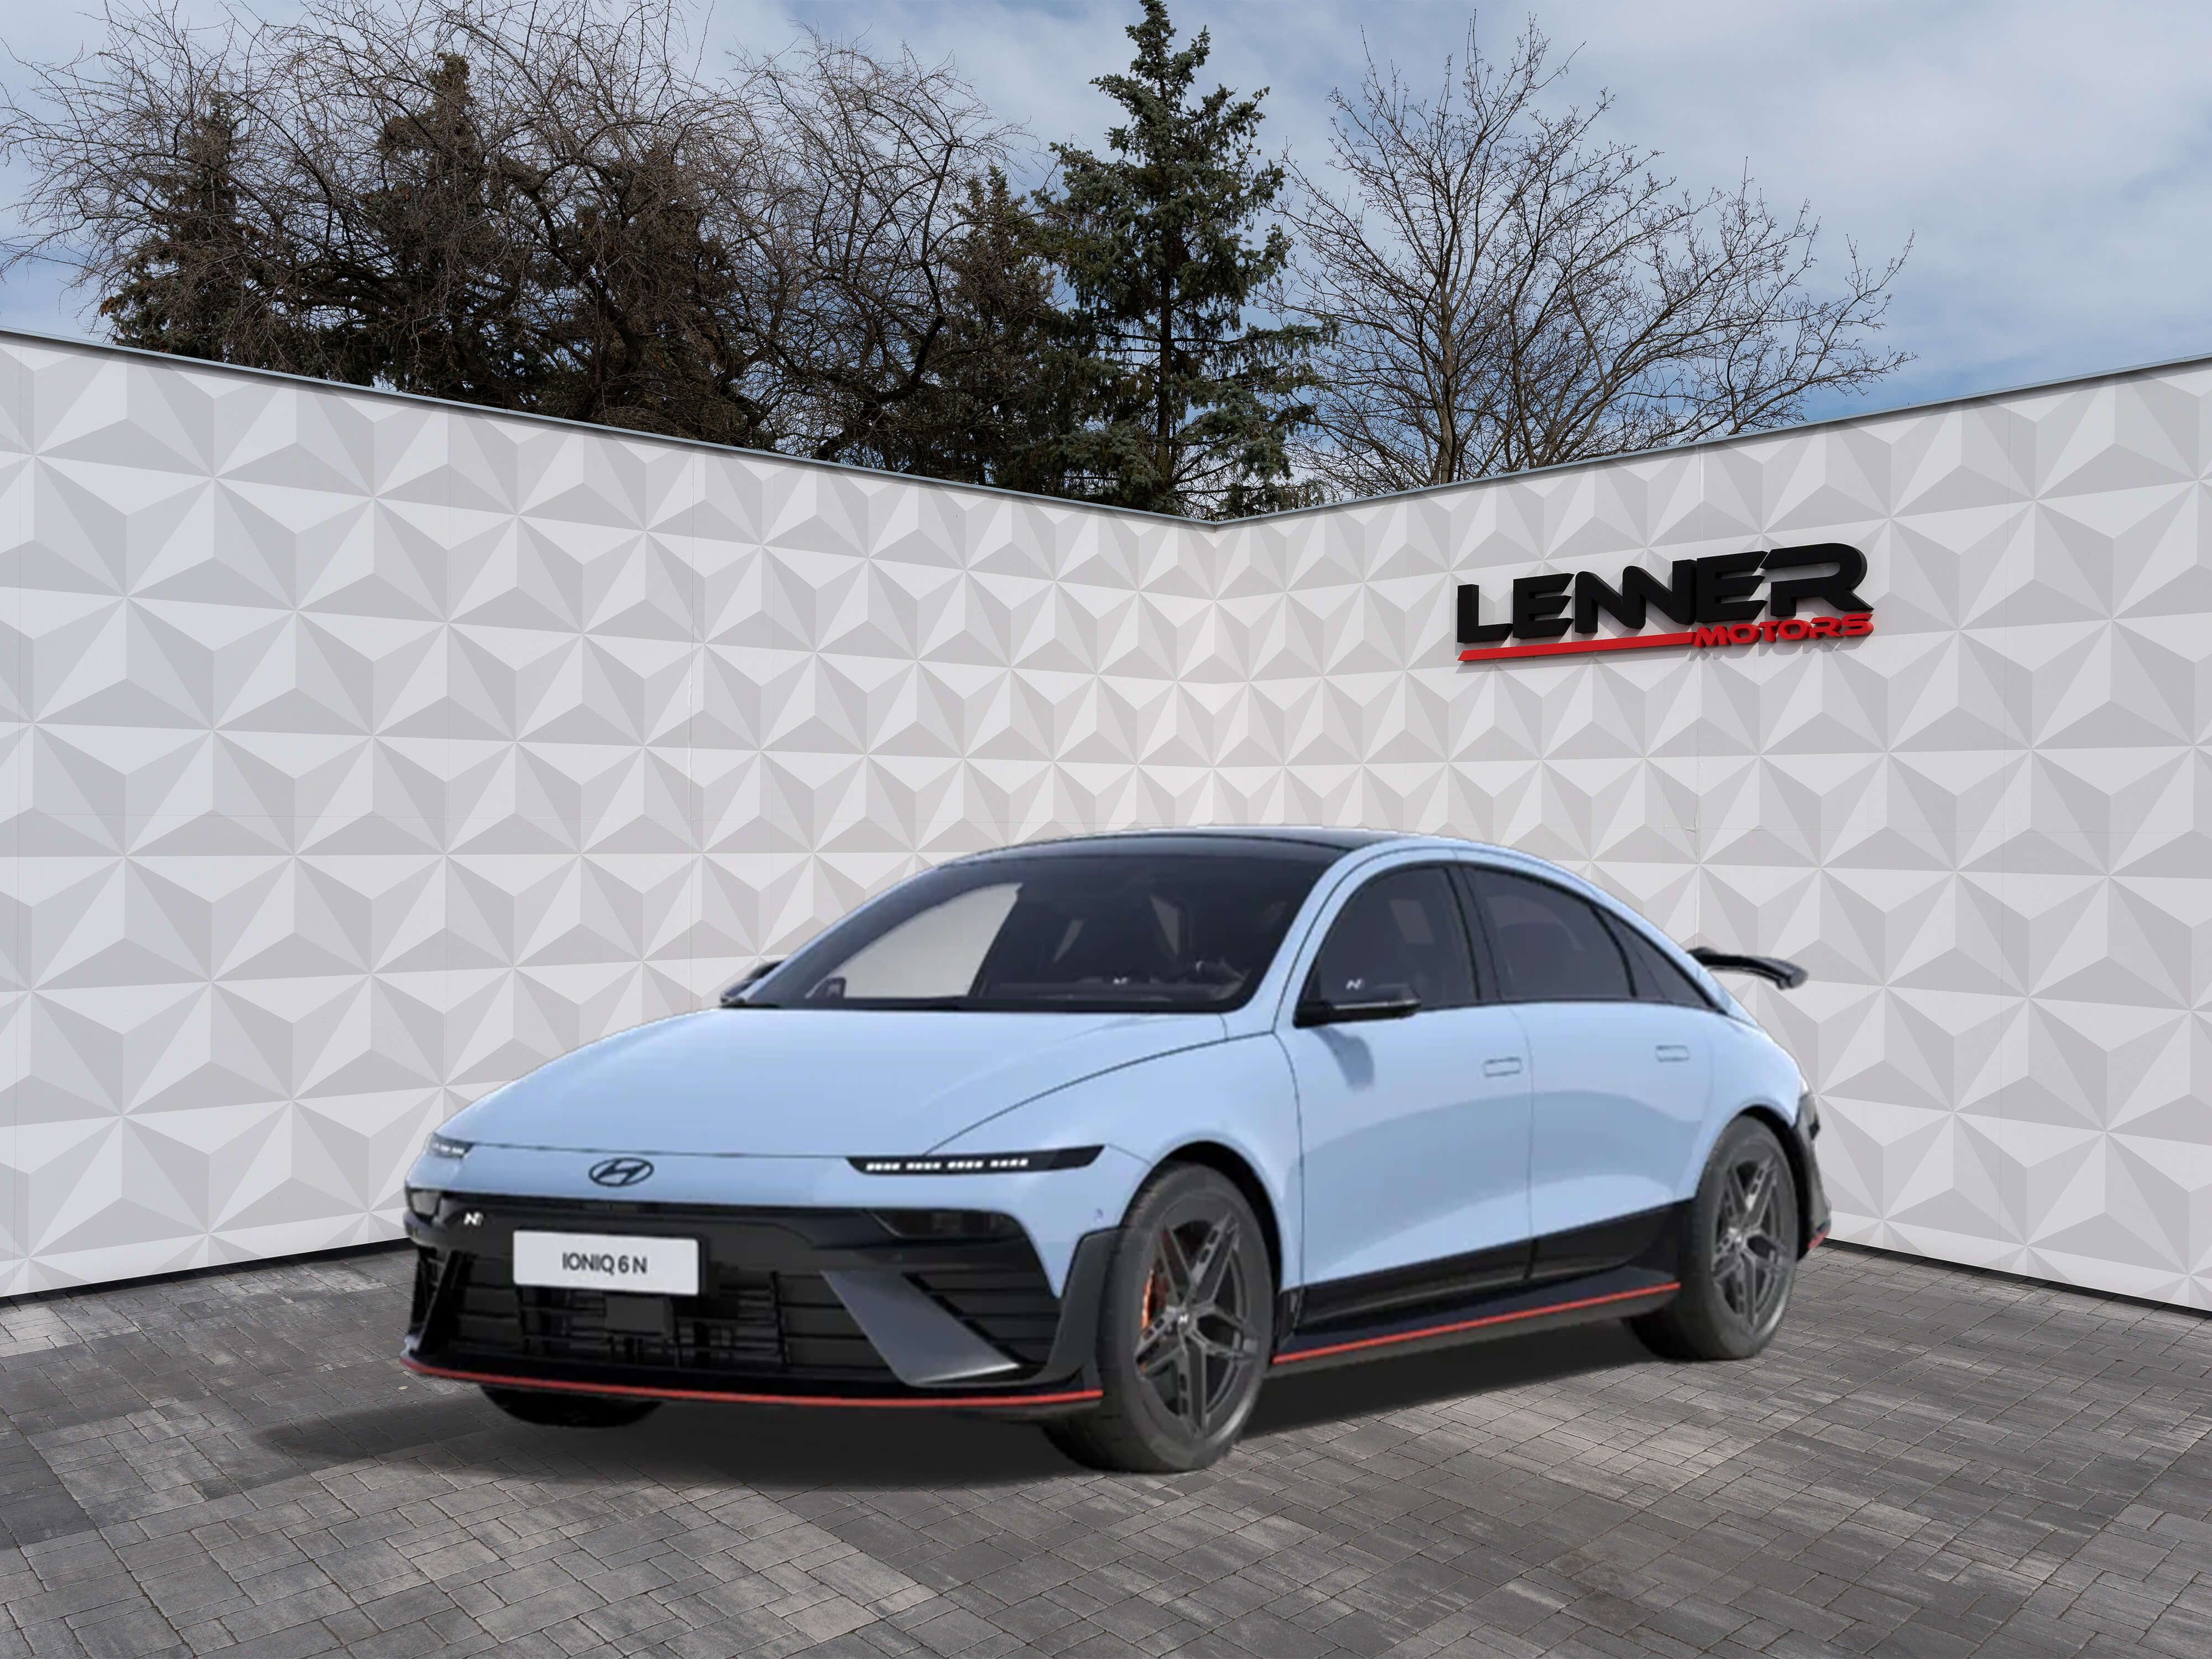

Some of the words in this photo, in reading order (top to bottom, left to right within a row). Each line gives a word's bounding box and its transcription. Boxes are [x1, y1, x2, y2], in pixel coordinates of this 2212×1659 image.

[1457, 542, 1874, 644] LENNER
[1693, 613, 1874, 648] MOTORS
[562, 1252, 614, 1276] IONIQ
[618, 1255, 629, 1274] 6
[633, 1256, 647, 1274] N
